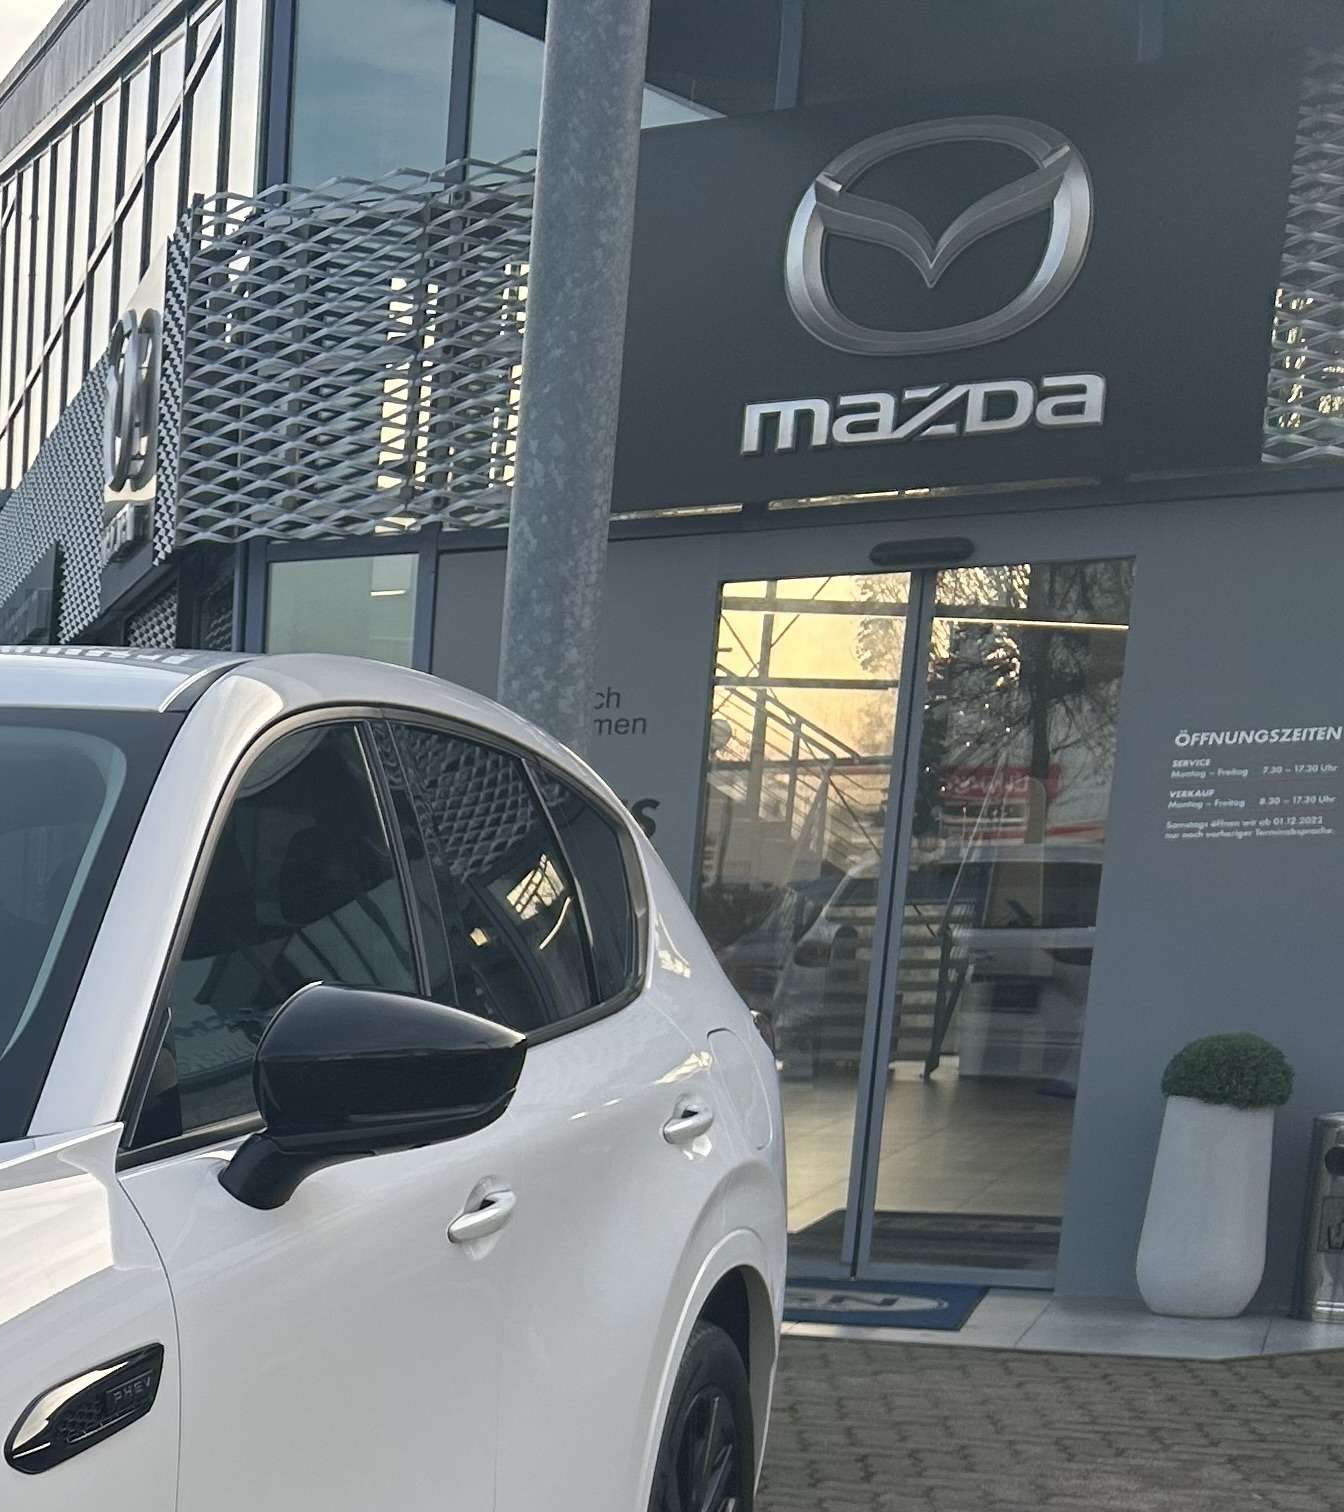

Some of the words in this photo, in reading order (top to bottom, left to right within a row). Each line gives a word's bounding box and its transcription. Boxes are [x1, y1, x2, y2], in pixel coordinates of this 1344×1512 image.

[741, 373, 1106, 456] mazda
[1174, 726, 1343, 747] ÖFFNUNGSZEITEN
[1170, 769, 1207, 779] Montag
[1217, 767, 1249, 778] Freitag
[1295, 764, 1319, 773] 17.30
[1320, 763, 1339, 772] Uhr
[1172, 758, 1211, 768] SERVICE
[1168, 800, 1204, 810] Montag
[1214, 798, 1246, 809] Freitag
[1293, 795, 1317, 804] 17.30
[1318, 794, 1337, 804] Uhr
[1169, 789, 1216, 799] VERKAUF
[113, 1376, 152, 1404] PHEV
